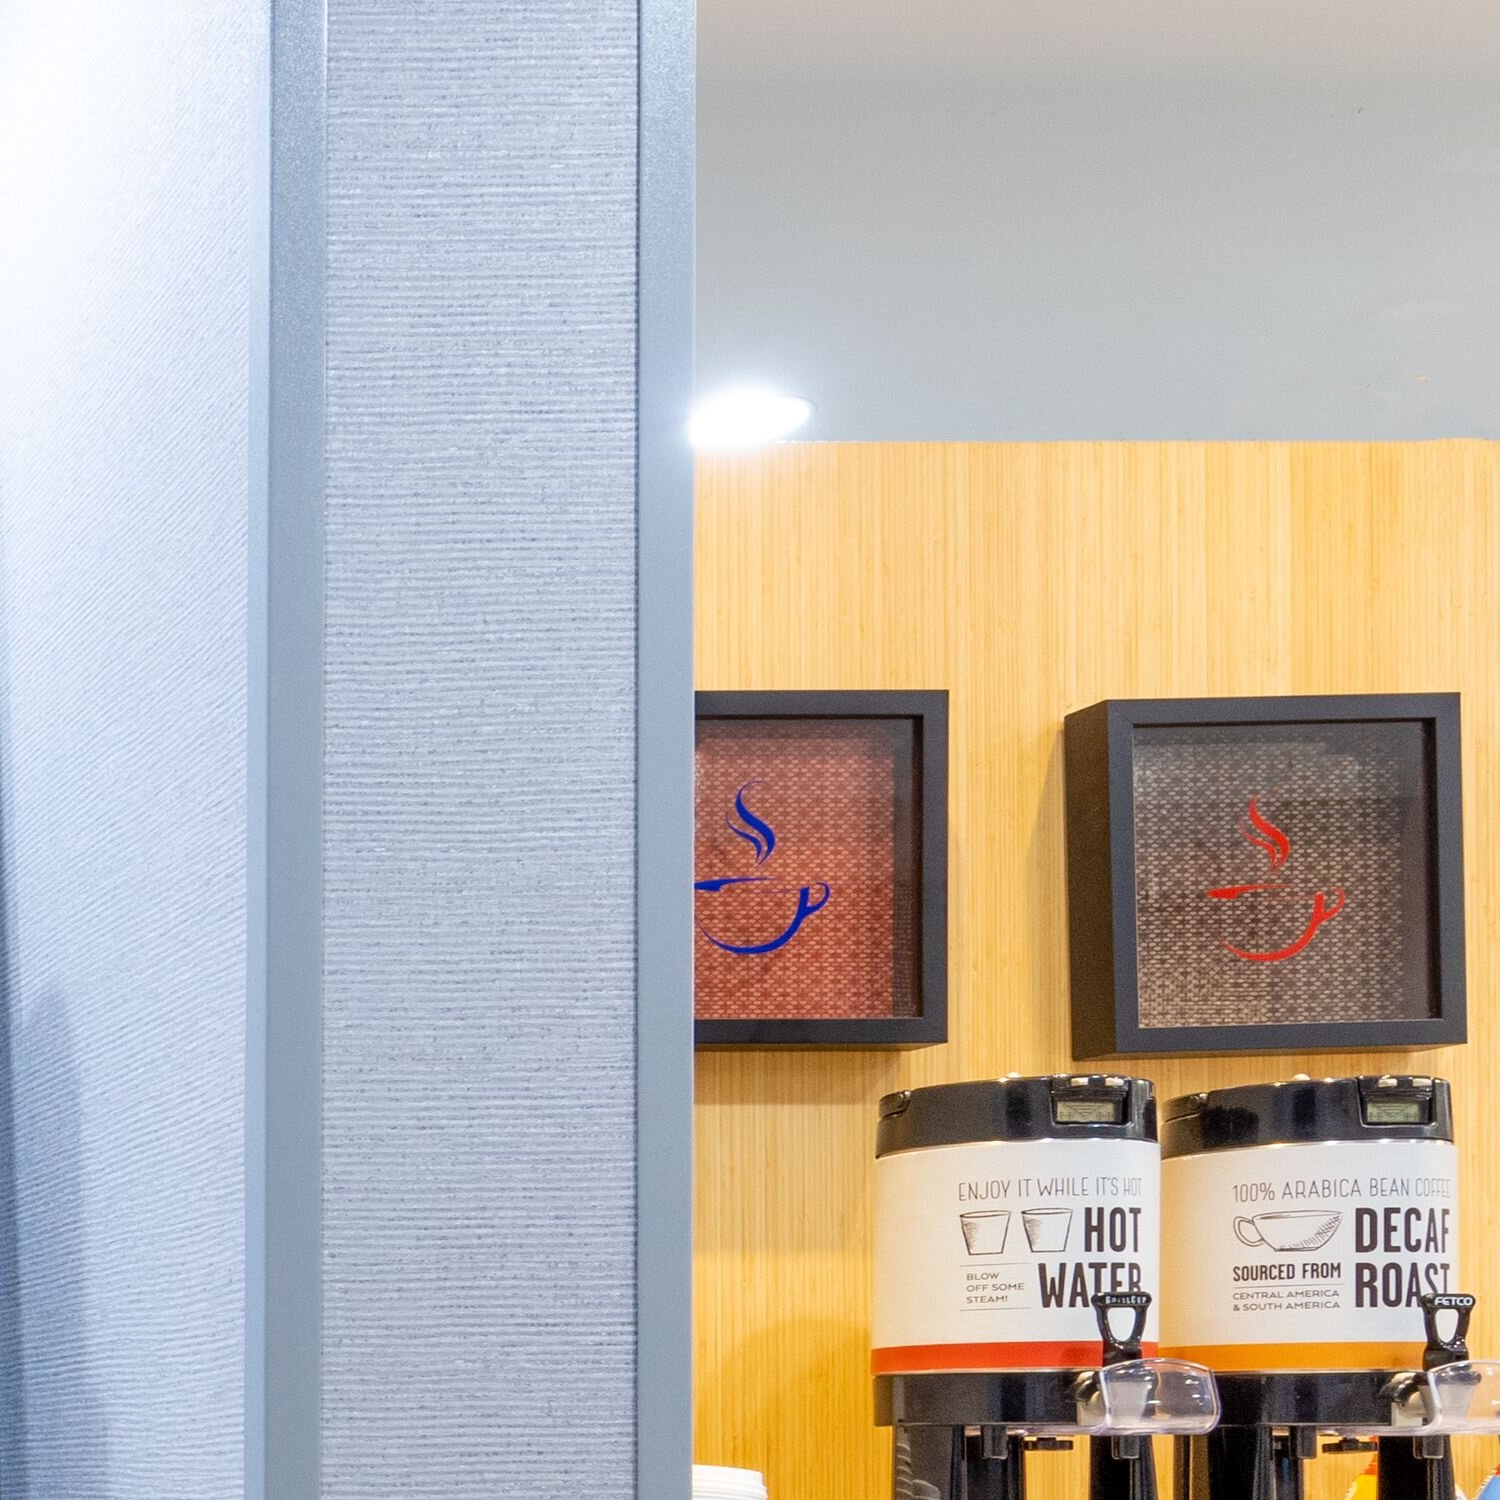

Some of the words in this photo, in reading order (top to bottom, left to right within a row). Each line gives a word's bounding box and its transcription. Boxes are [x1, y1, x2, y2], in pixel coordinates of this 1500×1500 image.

[959, 1180, 1011, 1201] ENJOY
[1018, 1179, 1032, 1197] IT
[1037, 1177, 1089, 1196] WHILE
[1096, 1177, 1119, 1196] IT'S
[1123, 1178, 1143, 1196] HOT
[1232, 1183, 1275, 1203] 100%
[1282, 1179, 1362, 1200] ARABICA
[1370, 1178, 1410, 1197] BEAN
[1416, 1178, 1451, 1198] COFFEE
[1084, 1207, 1142, 1253] HOT
[1355, 1207, 1450, 1253] DECAF
[967, 1272, 1000, 1281] BLOW
[1233, 1263, 1295, 1282] SOURCED
[1302, 1262, 1342, 1280] FROM
[966, 1284, 989, 1292] OFF
[992, 1282, 1025, 1291] SOME
[1038, 1262, 1142, 1309] WATER
[1232, 1291, 1283, 1301] CENTRAL
[1286, 1289, 1340, 1298] AMERICA
[1355, 1262, 1450, 1308] ROAST
[966, 1296, 1008, 1304] STEAM!
[1233, 1303, 1240, 1311] &
[1242, 1302, 1282, 1311] SOUTH
[1285, 1301, 1340, 1311] AMERICA
[1434, 1296, 1473, 1306] FETCO
